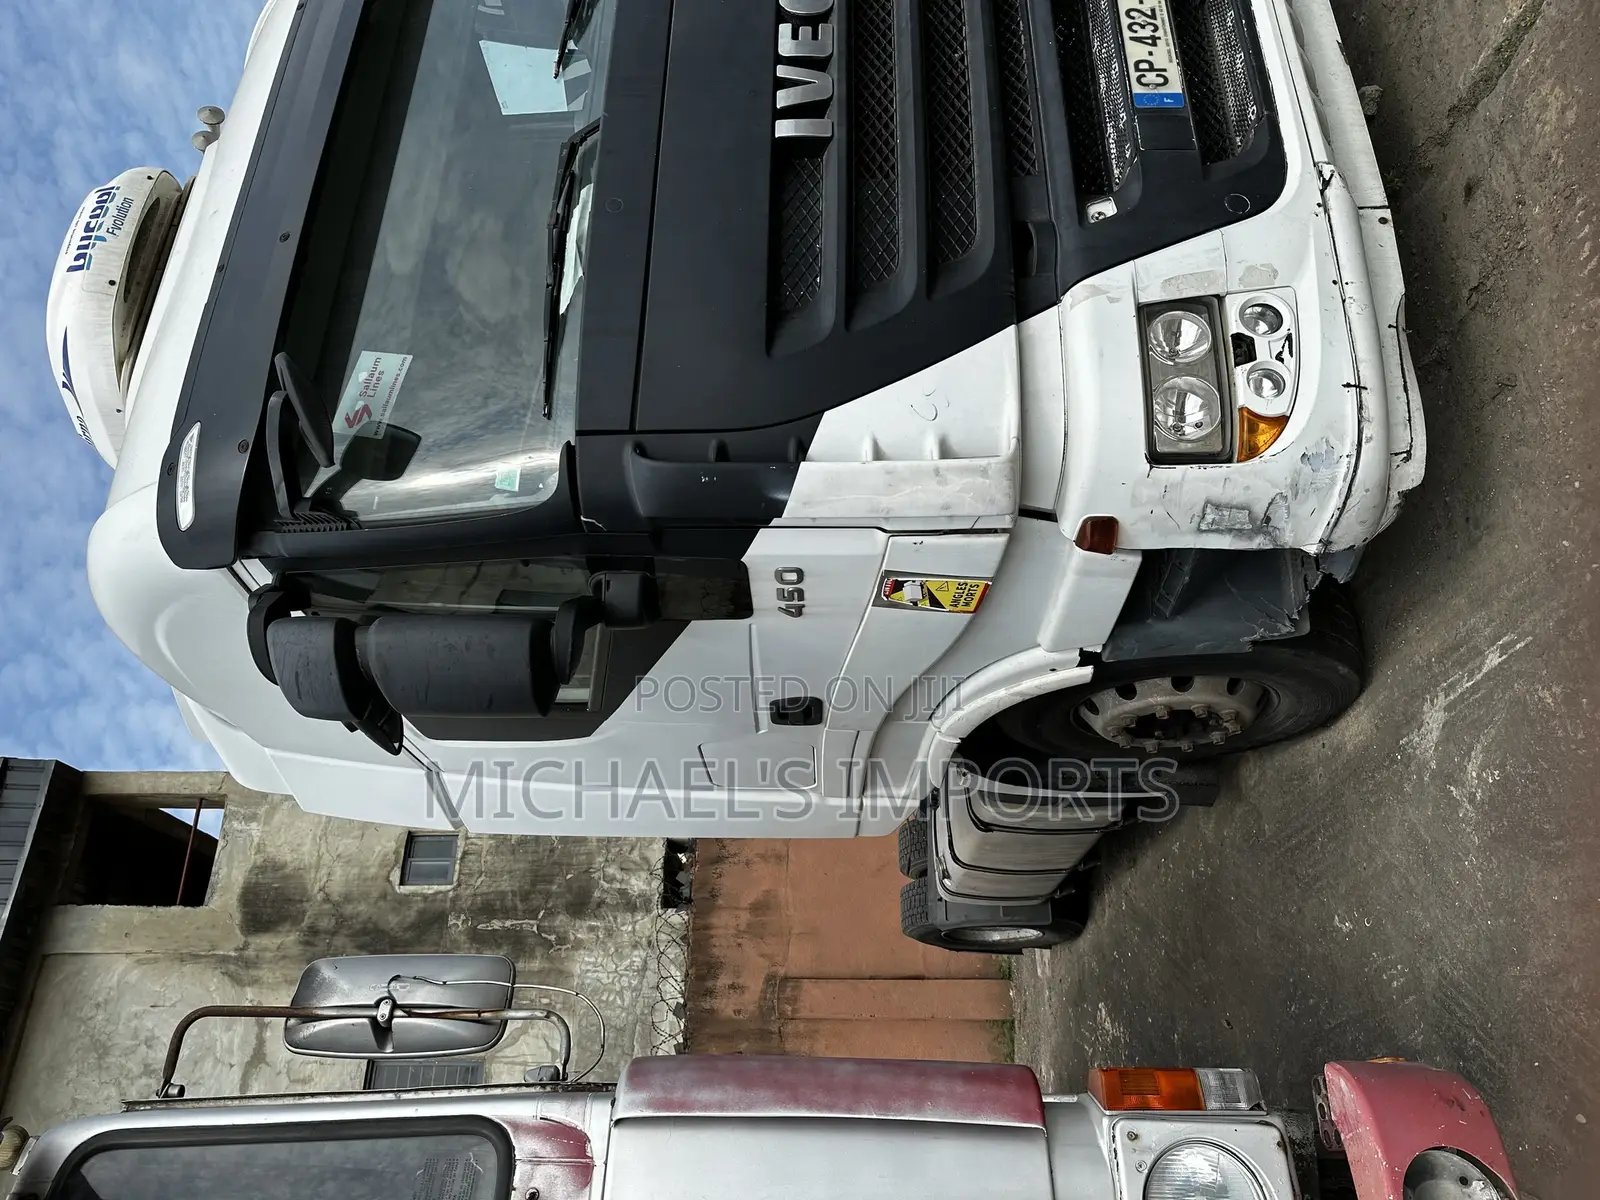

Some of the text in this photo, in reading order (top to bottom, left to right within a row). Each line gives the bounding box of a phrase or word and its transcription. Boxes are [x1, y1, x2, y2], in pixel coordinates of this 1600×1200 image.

[359, 356, 382, 398] Sallaum
[366, 370, 385, 398] Lines
[774, 566, 806, 618] 450
[949, 581, 969, 608] ANGLES
[961, 583, 980, 608] MORTS
